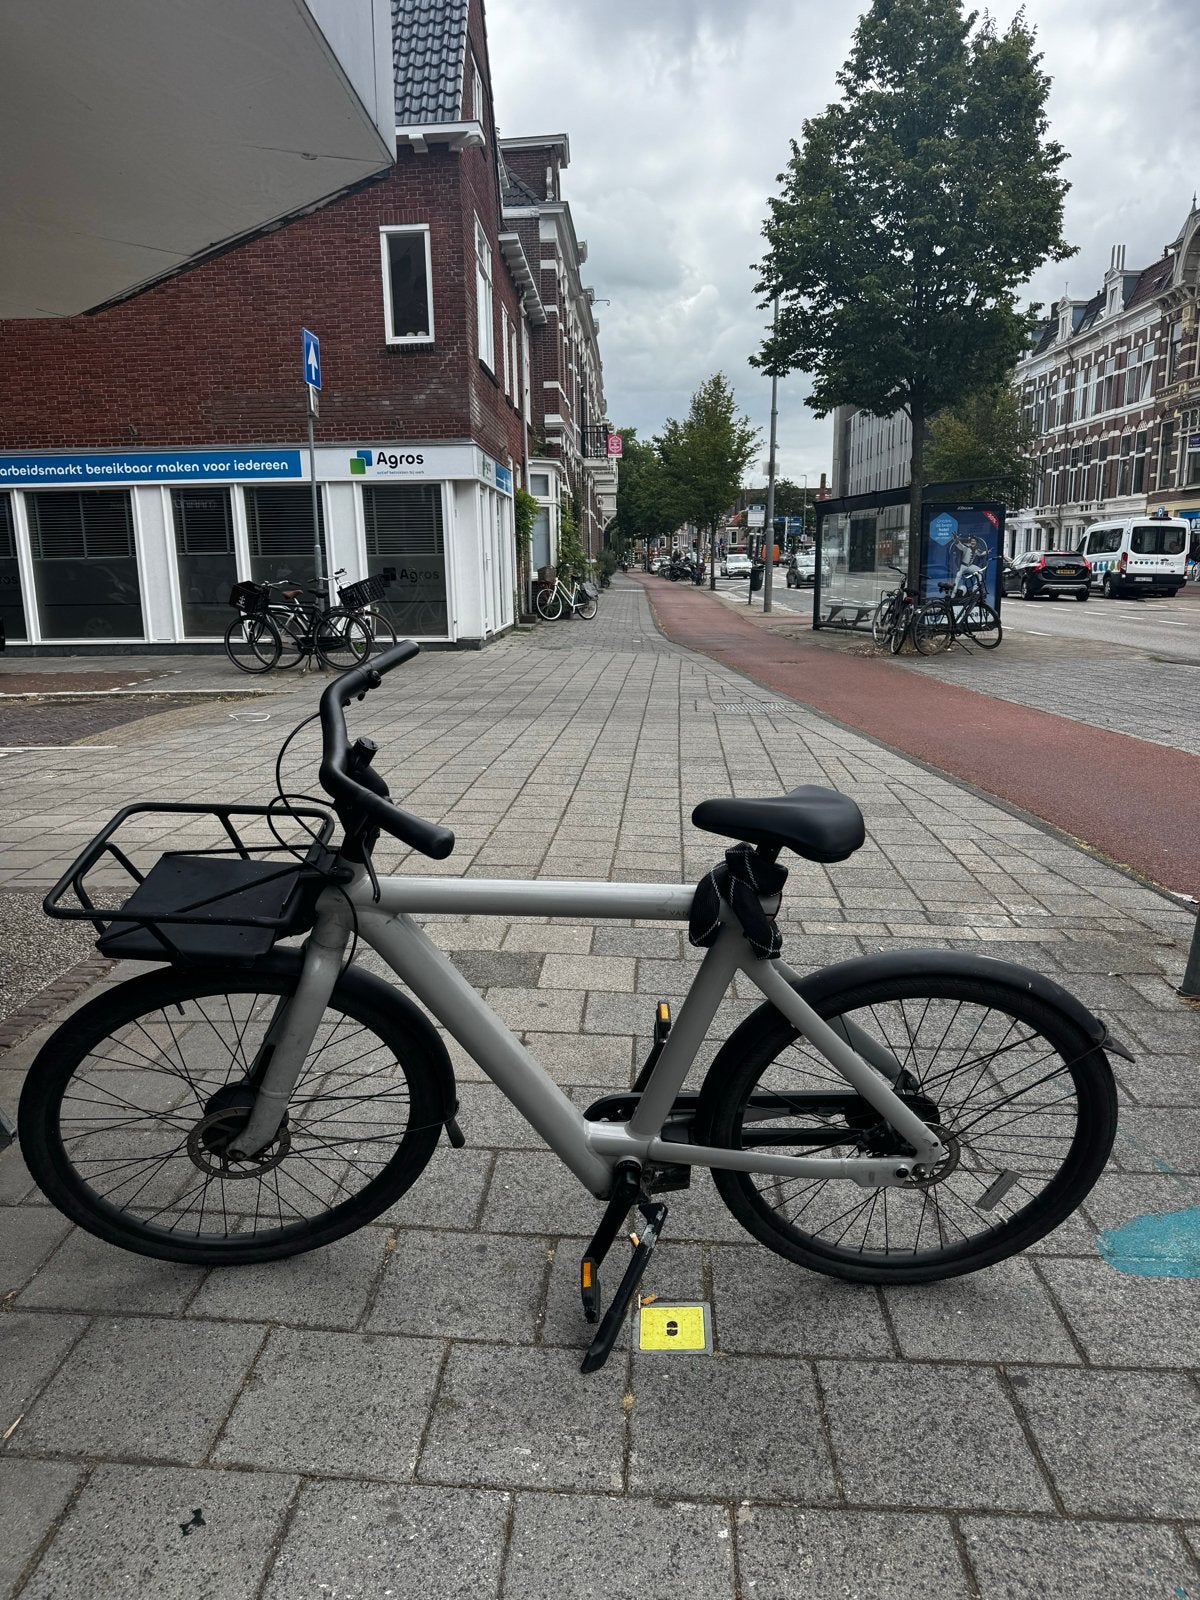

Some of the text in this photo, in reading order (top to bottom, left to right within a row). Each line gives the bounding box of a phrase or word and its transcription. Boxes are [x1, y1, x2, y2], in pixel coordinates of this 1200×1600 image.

[0, 459, 288, 476] arbeidsmarkt bereikbaar maken voor iedereen
[376, 451, 424, 469] Agros
[400, 568, 440, 583] Agros
